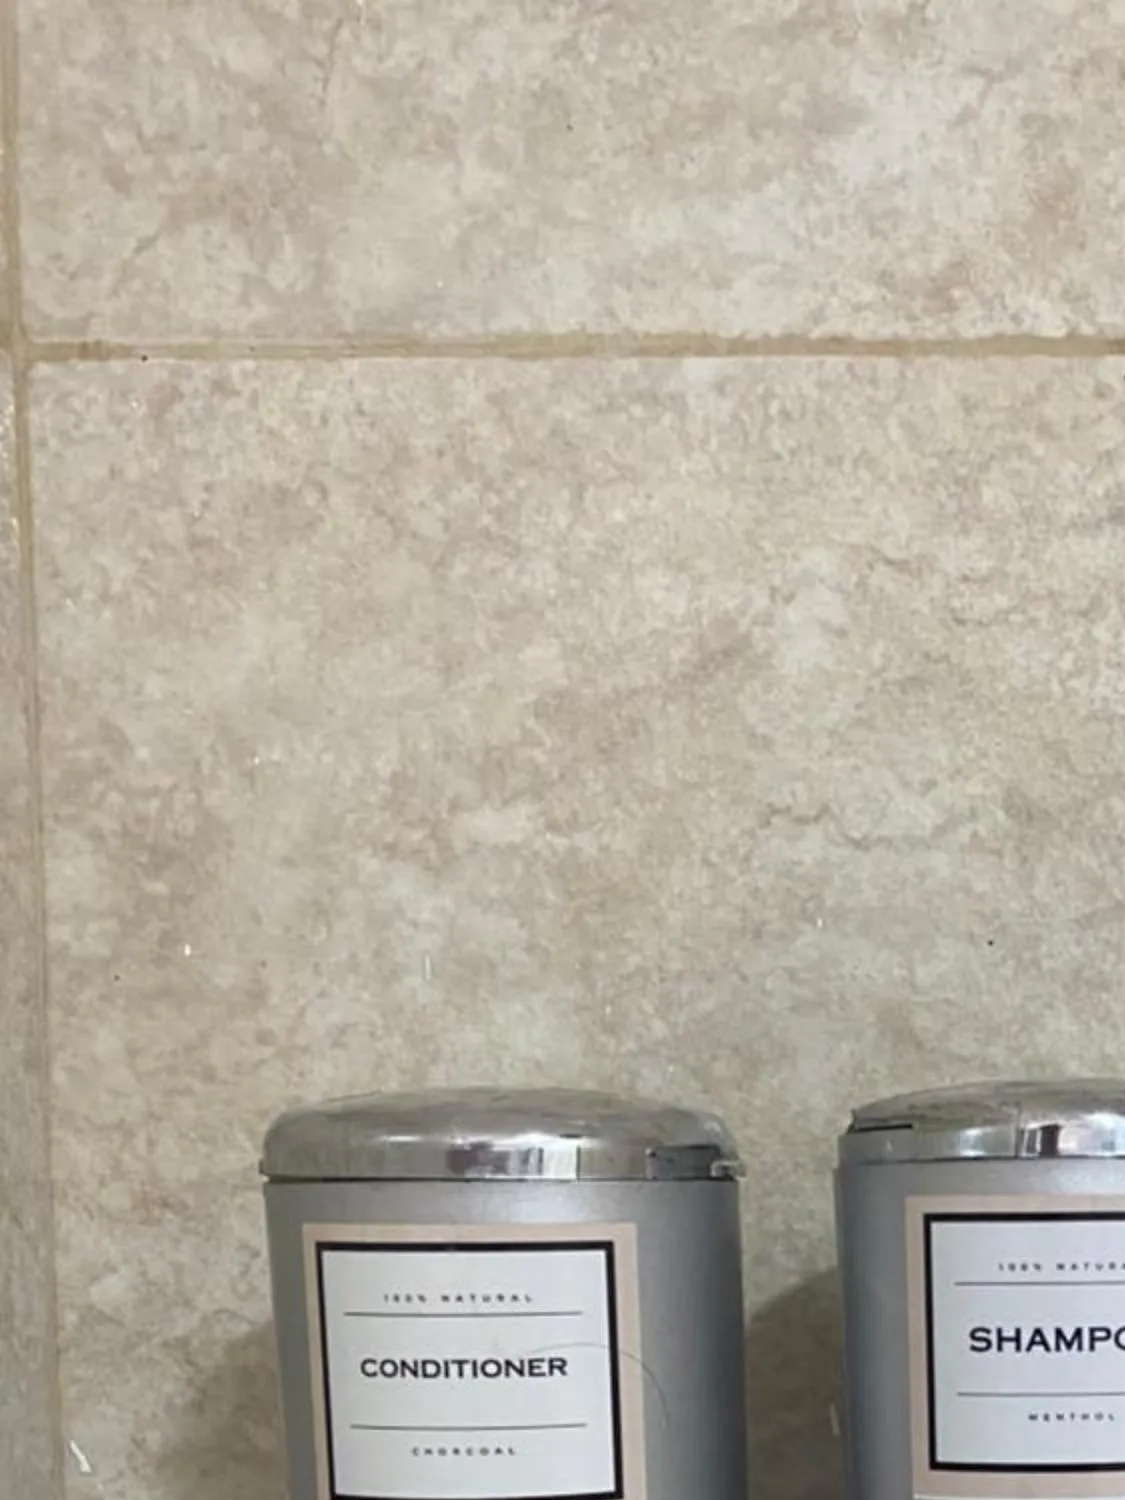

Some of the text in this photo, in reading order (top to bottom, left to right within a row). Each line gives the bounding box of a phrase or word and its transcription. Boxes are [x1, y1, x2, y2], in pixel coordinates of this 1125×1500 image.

[439, 1291, 534, 1305] NATURAL
[360, 1356, 569, 1380] CONDITIONER
[1026, 1410, 1118, 1424] MENTHOL
